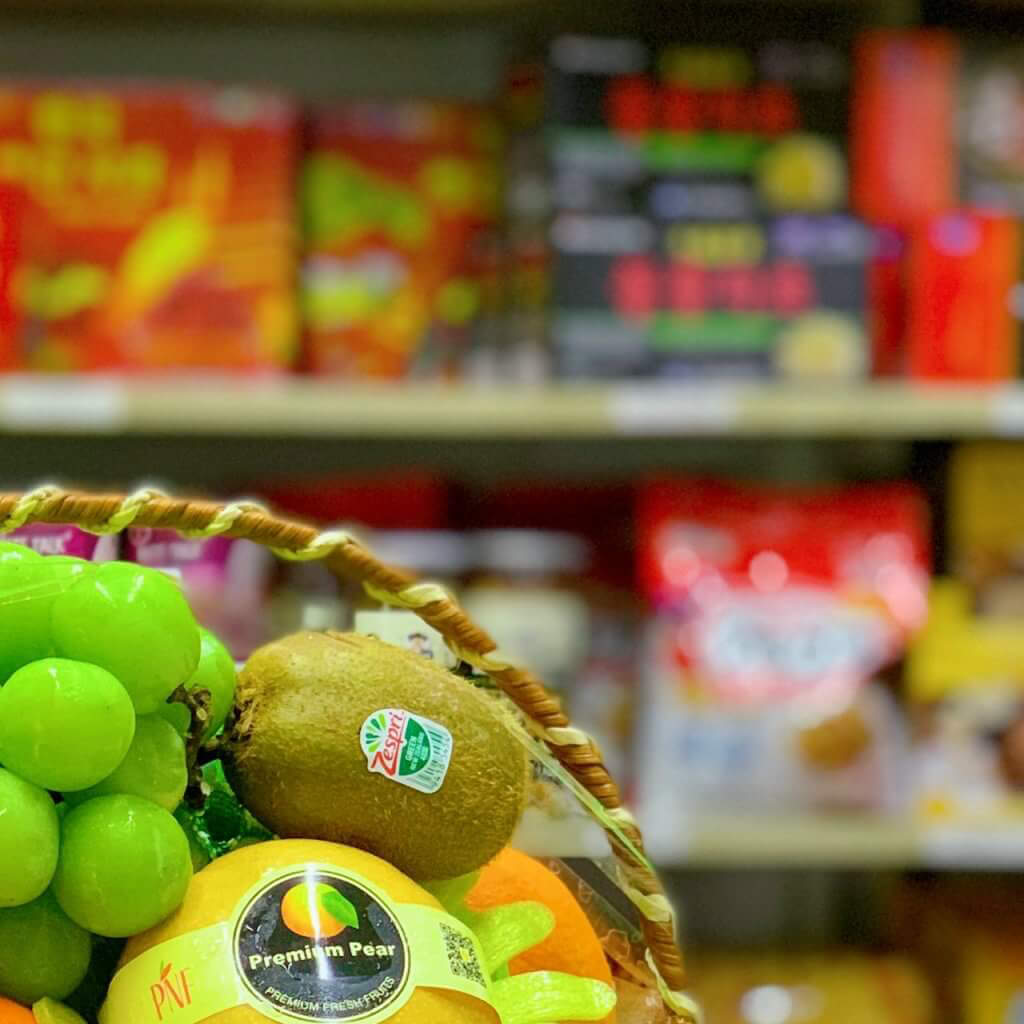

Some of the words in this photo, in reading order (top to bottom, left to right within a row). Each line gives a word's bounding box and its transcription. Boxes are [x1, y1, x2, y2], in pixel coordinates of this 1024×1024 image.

[370, 711, 404, 776] Zespri
[248, 943, 344, 970] Premium
[349, 942, 395, 957] Pear
[265, 986, 319, 1012] PREMIUM
[322, 998, 364, 1012] FRESH
